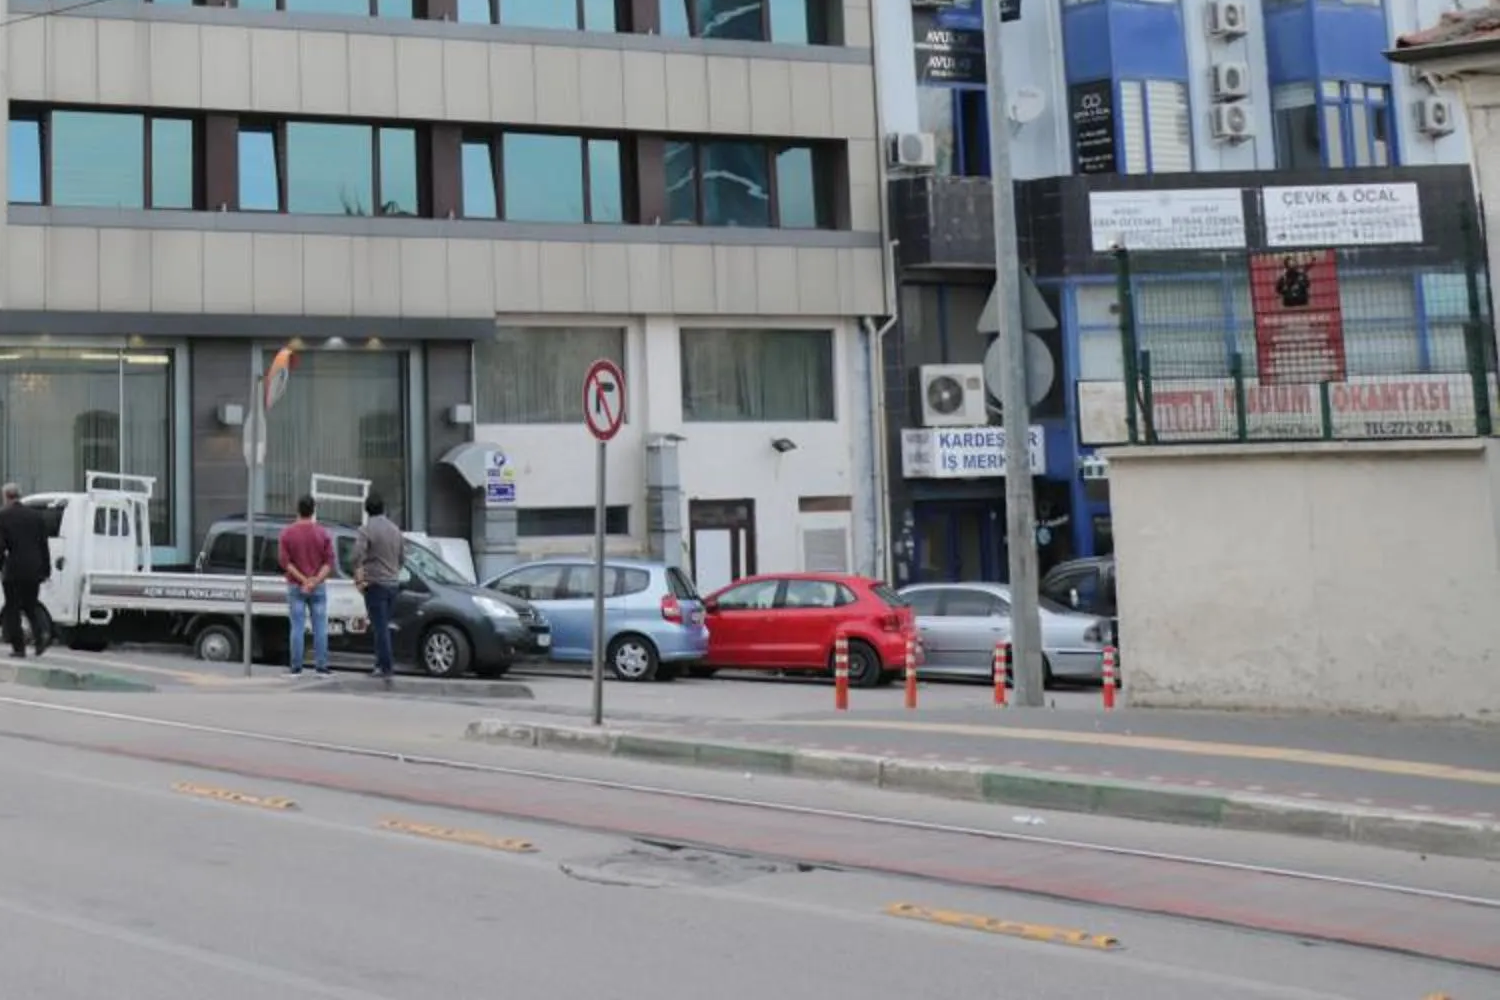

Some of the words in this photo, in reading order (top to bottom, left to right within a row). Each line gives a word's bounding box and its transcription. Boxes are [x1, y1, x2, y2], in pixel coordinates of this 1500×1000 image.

[1282, 190, 1332, 207] ÇEVİK
[1337, 191, 1348, 203] &
[1353, 188, 1399, 203] ÖCAL
[942, 453, 958, 471] İŞ
